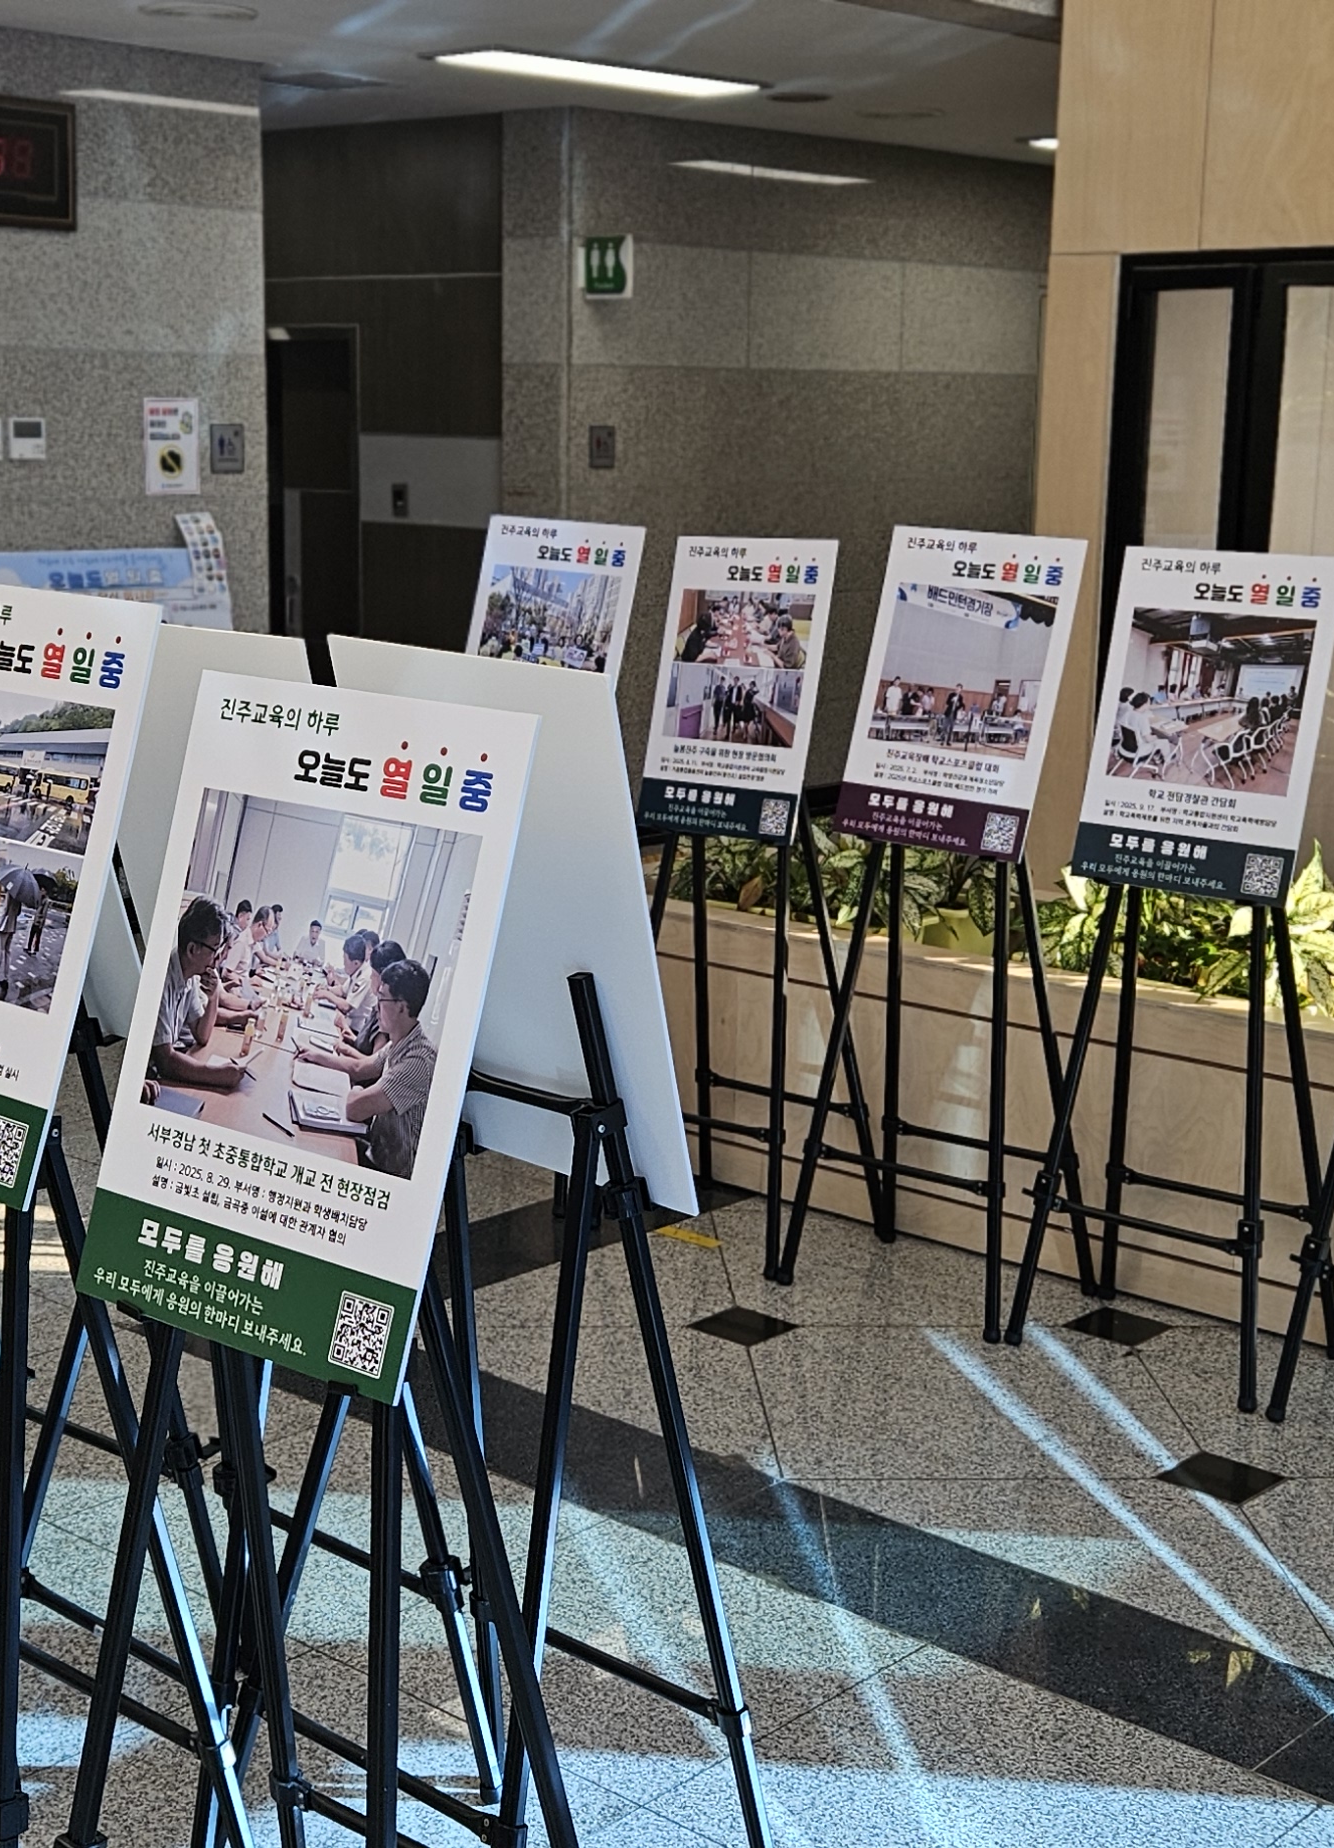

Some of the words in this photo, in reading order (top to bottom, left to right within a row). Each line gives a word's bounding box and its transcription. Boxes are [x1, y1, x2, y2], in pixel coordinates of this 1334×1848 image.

[500, 524, 540, 538] 진주교육의
[541, 528, 558, 540] 하루
[907, 536, 955, 551] 진주교육의
[958, 541, 977, 555] 하루
[537, 545, 573, 564] 오늘도
[688, 545, 729, 559] 진주교육의
[730, 546, 747, 560] 하루
[1141, 557, 1197, 574] 진주교육의
[1199, 560, 1221, 575] 하루
[726, 565, 763, 583] 오늘도
[952, 560, 996, 580] 오늘도
[926, 584, 994, 617] 배드민턴경기장
[1194, 582, 1244, 603] 오늘도
[220, 698, 302, 731] 진주교육의
[307, 708, 340, 736] 하루
[294, 749, 371, 792] 오늘도
[664, 785, 698, 802] 모두를
[701, 789, 736, 807] 응원해
[868, 792, 909, 812] 모두를
[912, 799, 955, 819] 응원해
[1148, 788, 1164, 801] 학교
[1210, 794, 1237, 809] 간담회
[1109, 832, 1156, 854] 모두를
[1160, 839, 1208, 860] 응원해
[147, 1123, 197, 1152] 서부경남
[199, 1136, 211, 1156] 첫
[212, 1140, 288, 1179] 초중통합학교
[293, 1162, 317, 1188] 개교
[320, 1172, 334, 1193] 전
[337, 1177, 392, 1211] 현장점검
[155, 1155, 173, 1173] 일시
[178, 1162, 204, 1184] 2025.
[234, 1179, 260, 1198] 부서명
[268, 1189, 312, 1214] 행정지원과
[313, 1203, 368, 1232] 학생배치담당
[151, 1174, 170, 1191] 설명
[175, 1181, 200, 1201] 금빛초
[223, 1196, 250, 1215] 금곡중
[252, 1203, 277, 1225] 이설에
[279, 1211, 298, 1231] 대한
[299, 1217, 326, 1240] 관계자
[328, 1228, 347, 1246] 협의
[137, 1217, 207, 1265] 모두를
[212, 1243, 285, 1291] 응원해
[143, 1258, 202, 1294] 진주교육을
[204, 1281, 264, 1316] 이끌어가는
[94, 1266, 118, 1289] 우리
[118, 1277, 165, 1306] 모두에게
[166, 1291, 200, 1320] 응원의
[204, 1302, 239, 1334] 한마디
[241, 1316, 307, 1356] 보내주세요.
